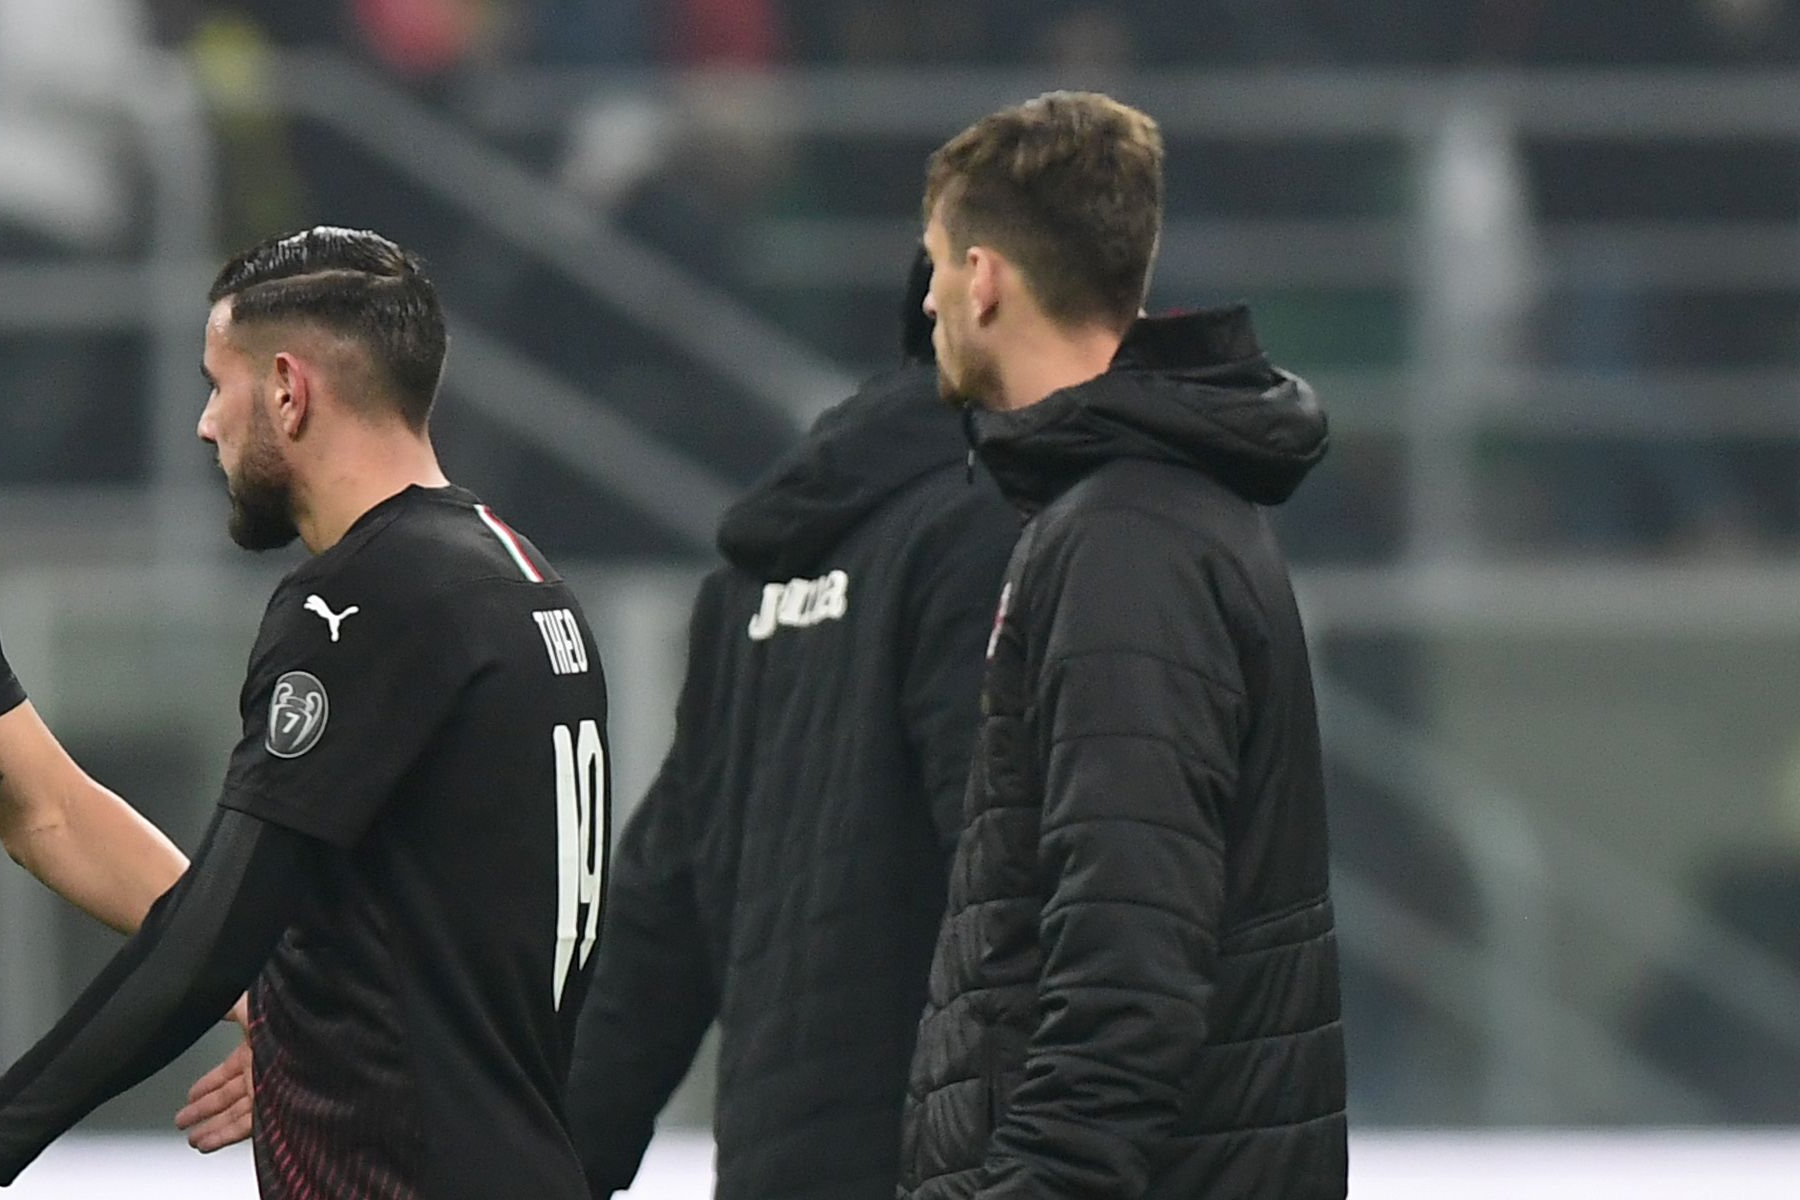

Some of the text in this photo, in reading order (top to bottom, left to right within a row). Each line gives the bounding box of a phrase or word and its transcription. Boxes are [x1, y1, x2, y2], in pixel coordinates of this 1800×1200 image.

[532, 608, 588, 675] THEO
[282, 711, 300, 733] 7
[553, 719, 603, 1012] 19
